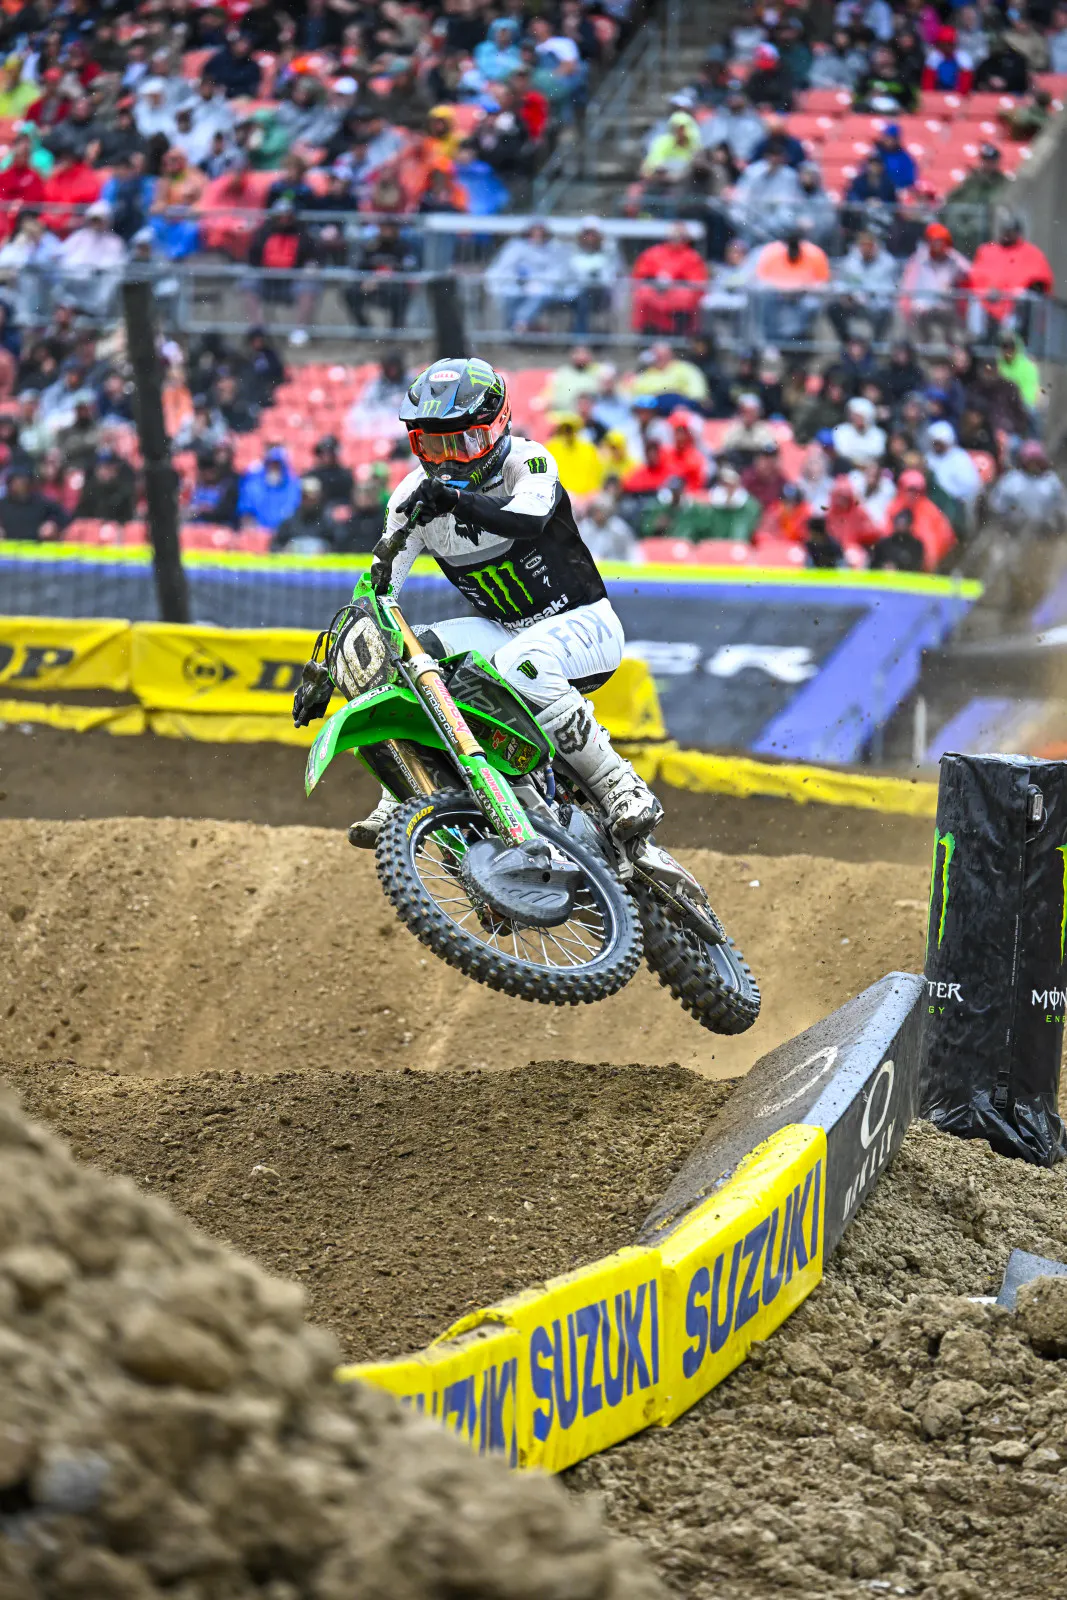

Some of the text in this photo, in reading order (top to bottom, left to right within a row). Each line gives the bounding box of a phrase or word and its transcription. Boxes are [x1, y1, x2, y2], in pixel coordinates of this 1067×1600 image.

[495, 593, 569, 631] awasaki
[548, 609, 612, 657] FOX
[421, 685, 447, 722] CIRCUIT
[443, 722, 459, 744] PRO
[387, 743, 422, 796] PRO CIRCUI
[480, 767, 507, 803] BRAKING
[405, 805, 435, 839] DUNLOP
[501, 804, 519, 828] TECH
[682, 1158, 822, 1380] SUZUKI
[529, 1278, 659, 1442] SUZUKI
[401, 1357, 518, 1470] ZUKI
